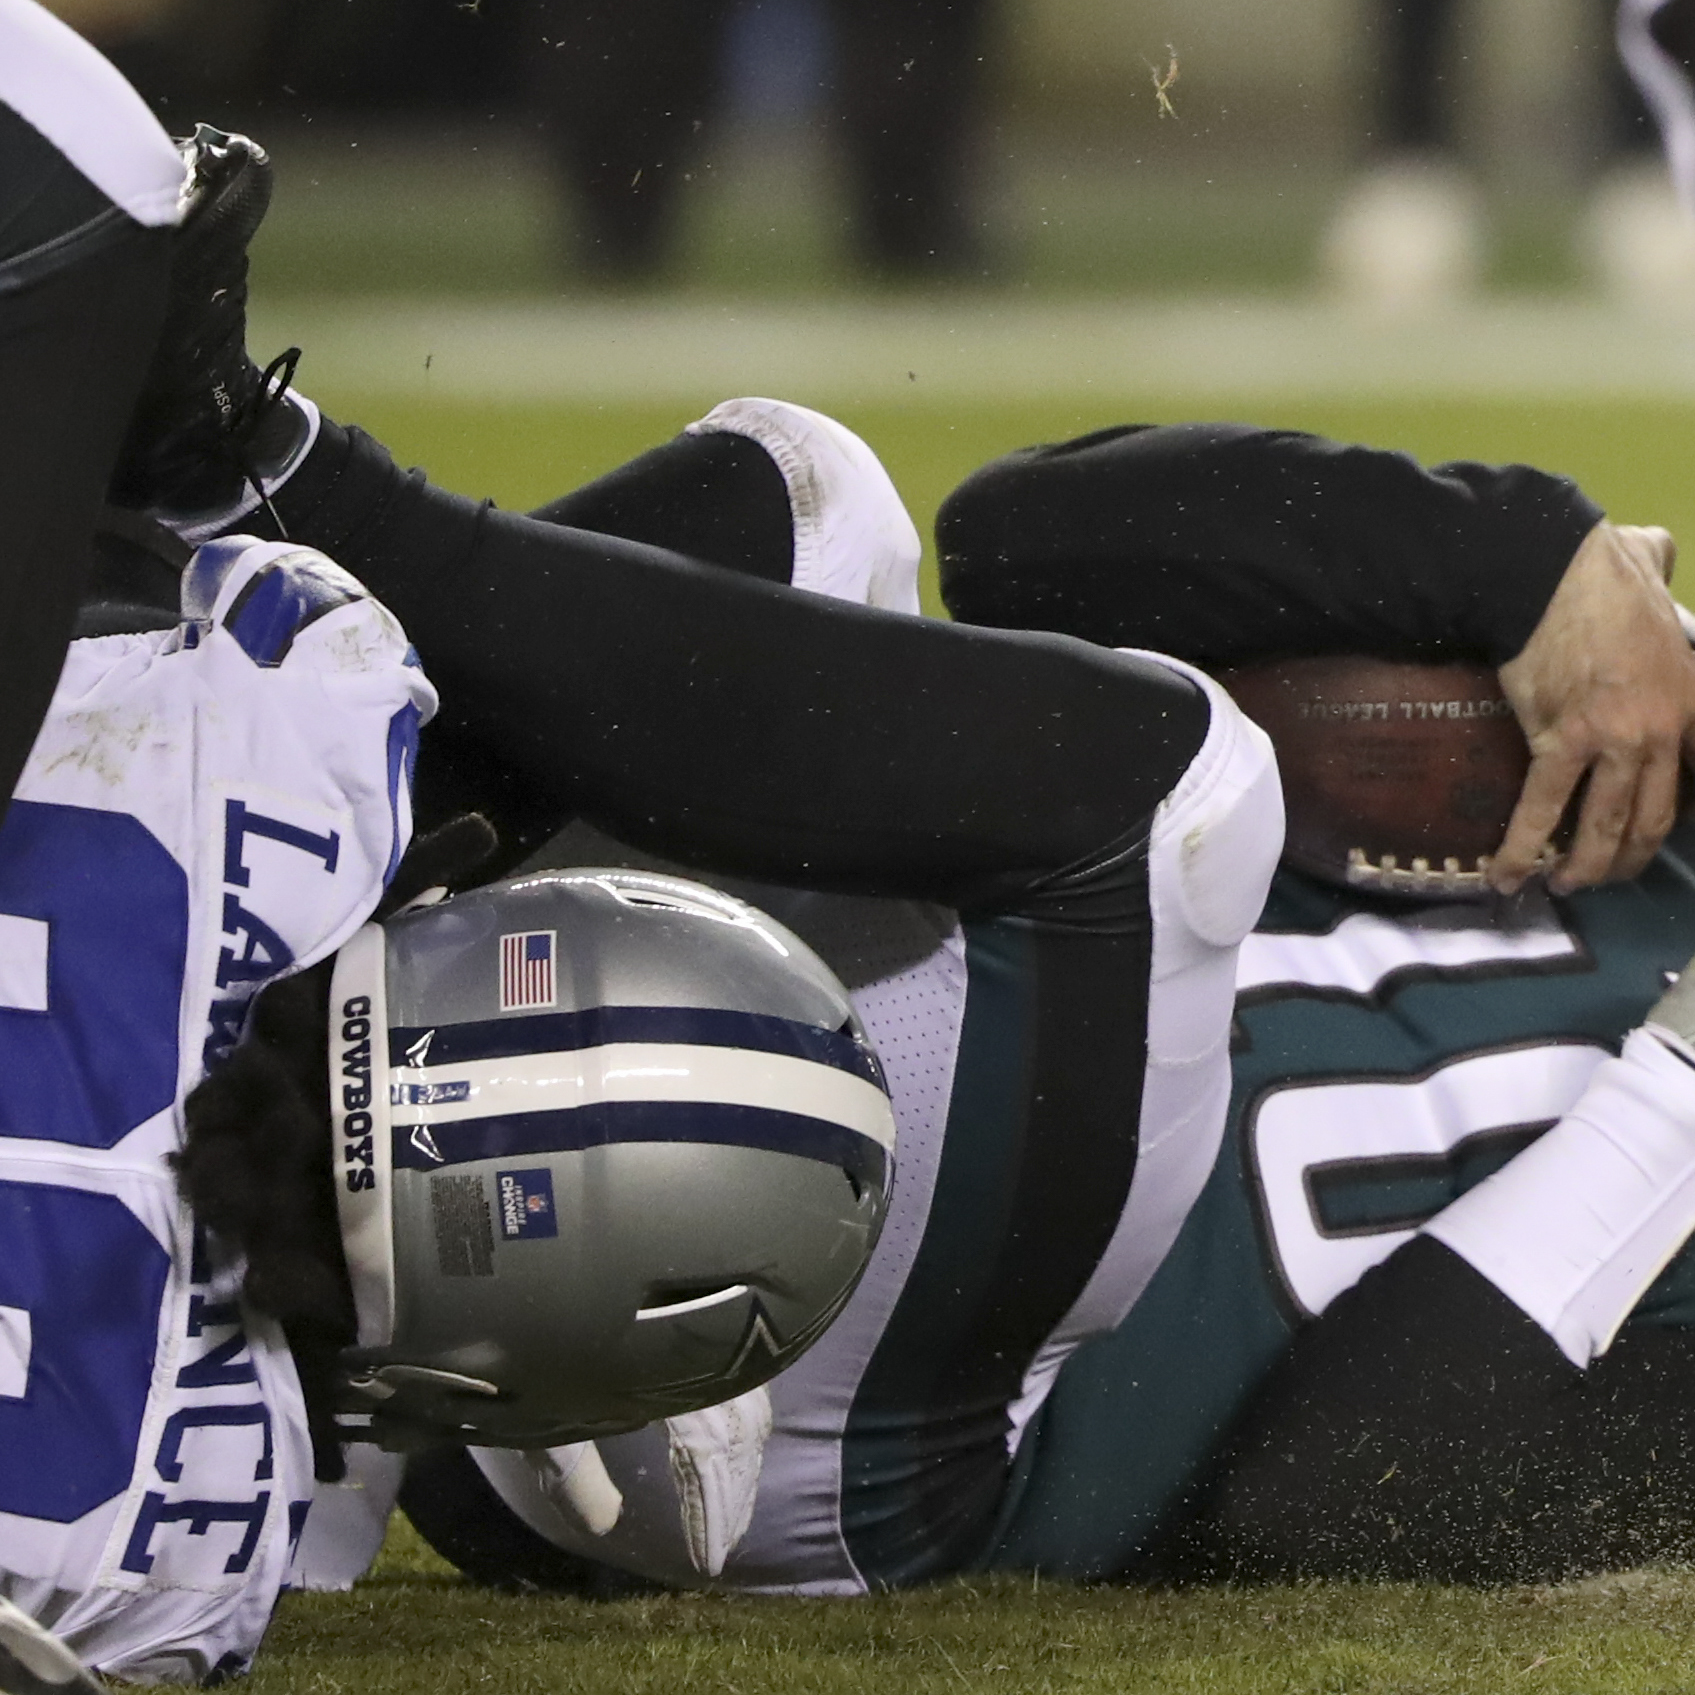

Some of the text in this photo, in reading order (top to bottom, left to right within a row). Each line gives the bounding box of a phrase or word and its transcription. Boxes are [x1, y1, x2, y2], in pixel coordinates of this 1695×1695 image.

[1297, 699, 1513, 721] OOTBALL LEAGUE
[342, 995, 375, 1193] COWBOYS
[501, 1176, 519, 1235] CHANGE
[514, 1185, 527, 1225] INSPIRE
